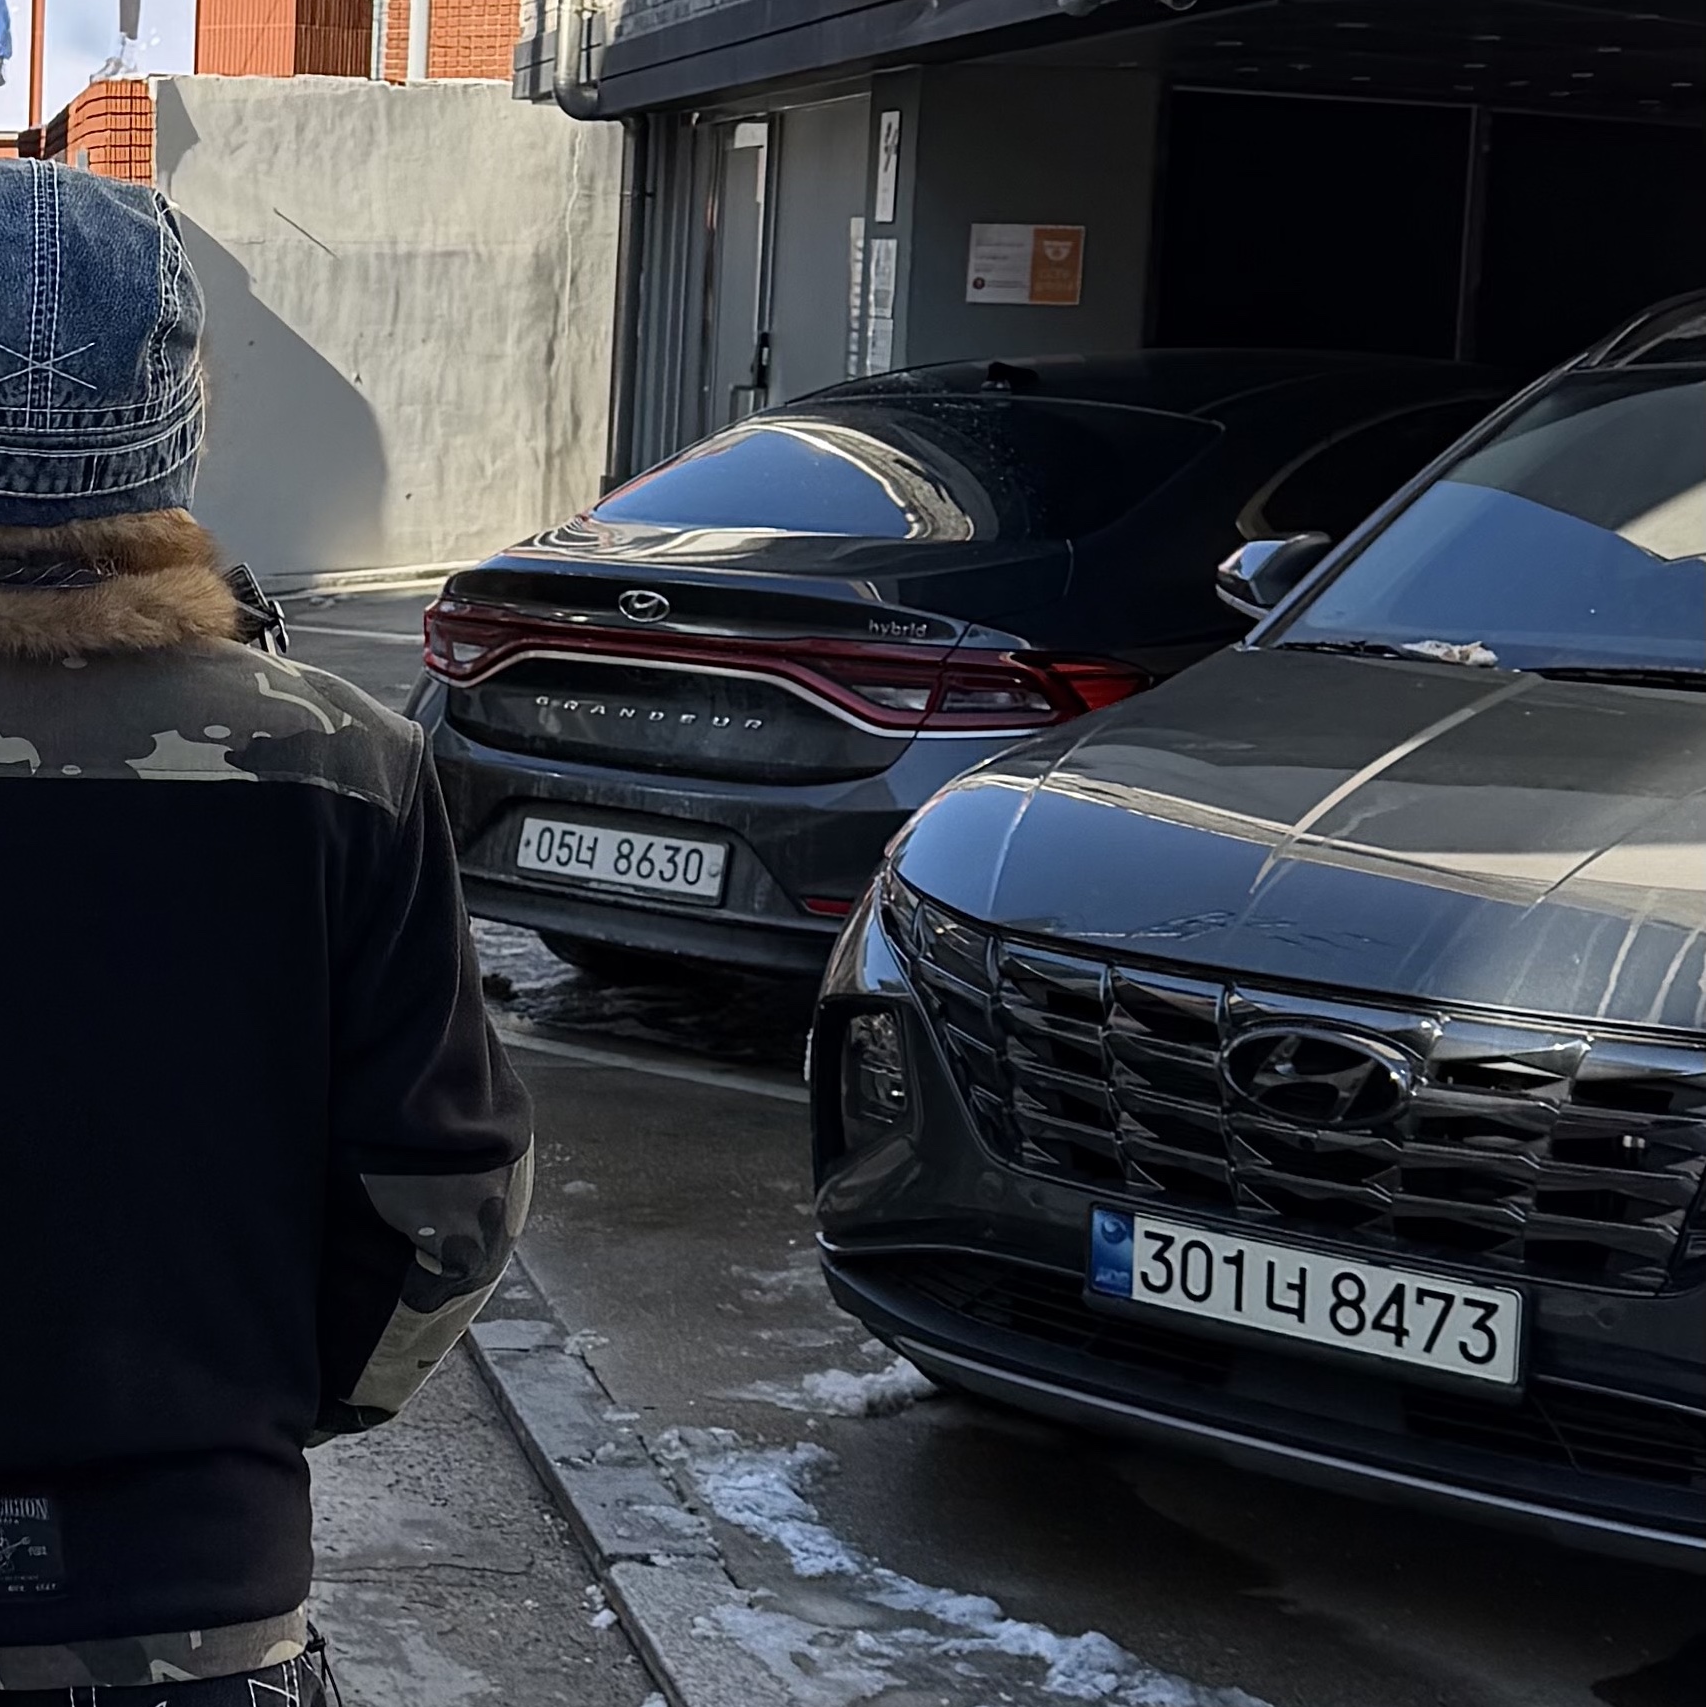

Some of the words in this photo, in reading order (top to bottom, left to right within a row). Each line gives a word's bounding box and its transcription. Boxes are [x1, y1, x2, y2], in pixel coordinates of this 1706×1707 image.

[868, 619, 928, 637] hybrid
[535, 696, 763, 729] GRANDEUR
[613, 838, 704, 886] 8630
[1140, 1230, 1307, 1324] 301너
[1328, 1271, 1500, 1365] 8473
